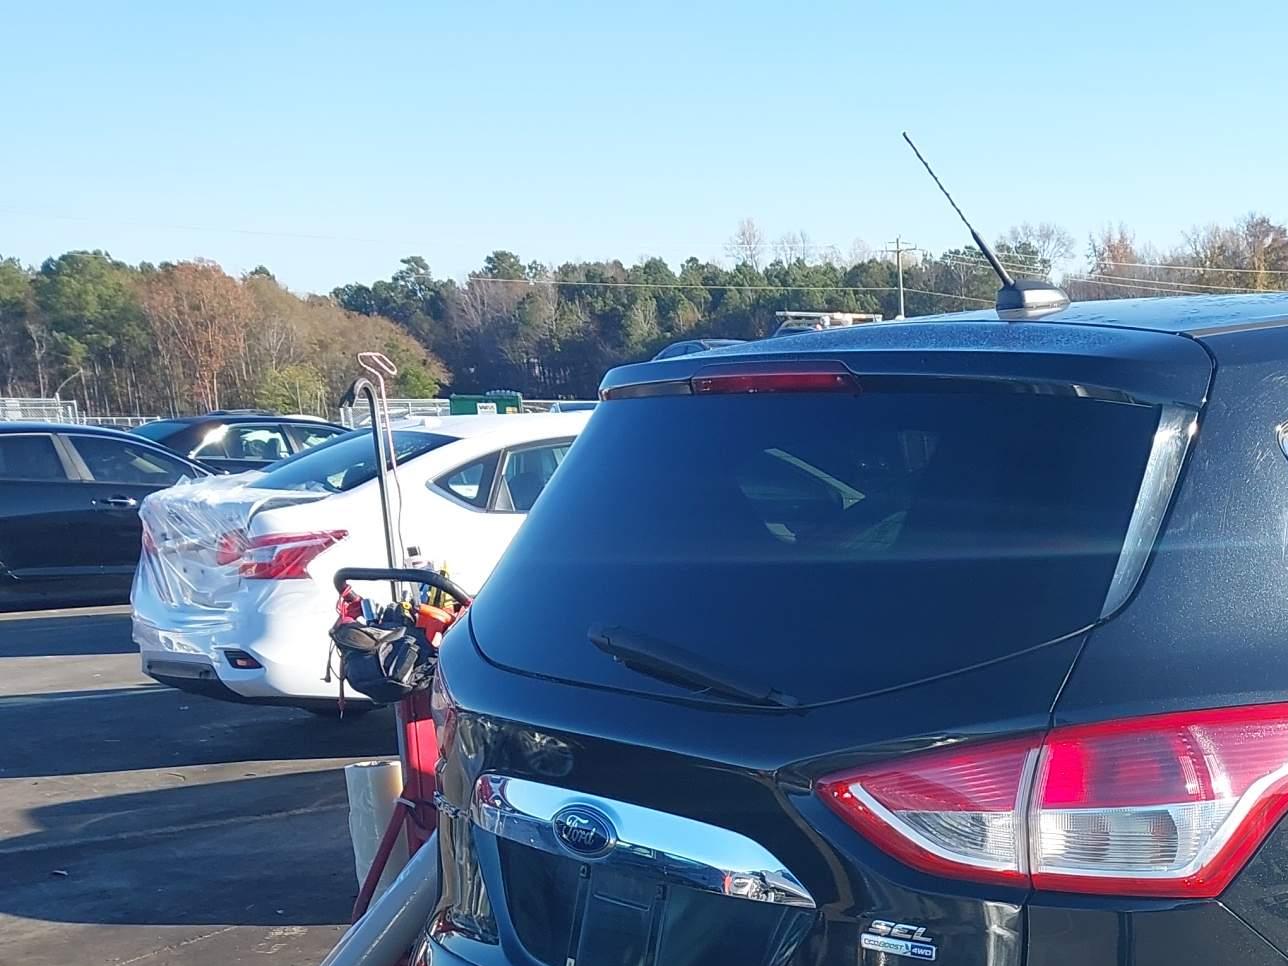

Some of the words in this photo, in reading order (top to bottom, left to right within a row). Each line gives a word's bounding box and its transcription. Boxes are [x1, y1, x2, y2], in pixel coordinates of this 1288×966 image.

[562, 814, 597, 847] Ford
[868, 919, 933, 943] SEL
[911, 946, 933, 958] 4WD
